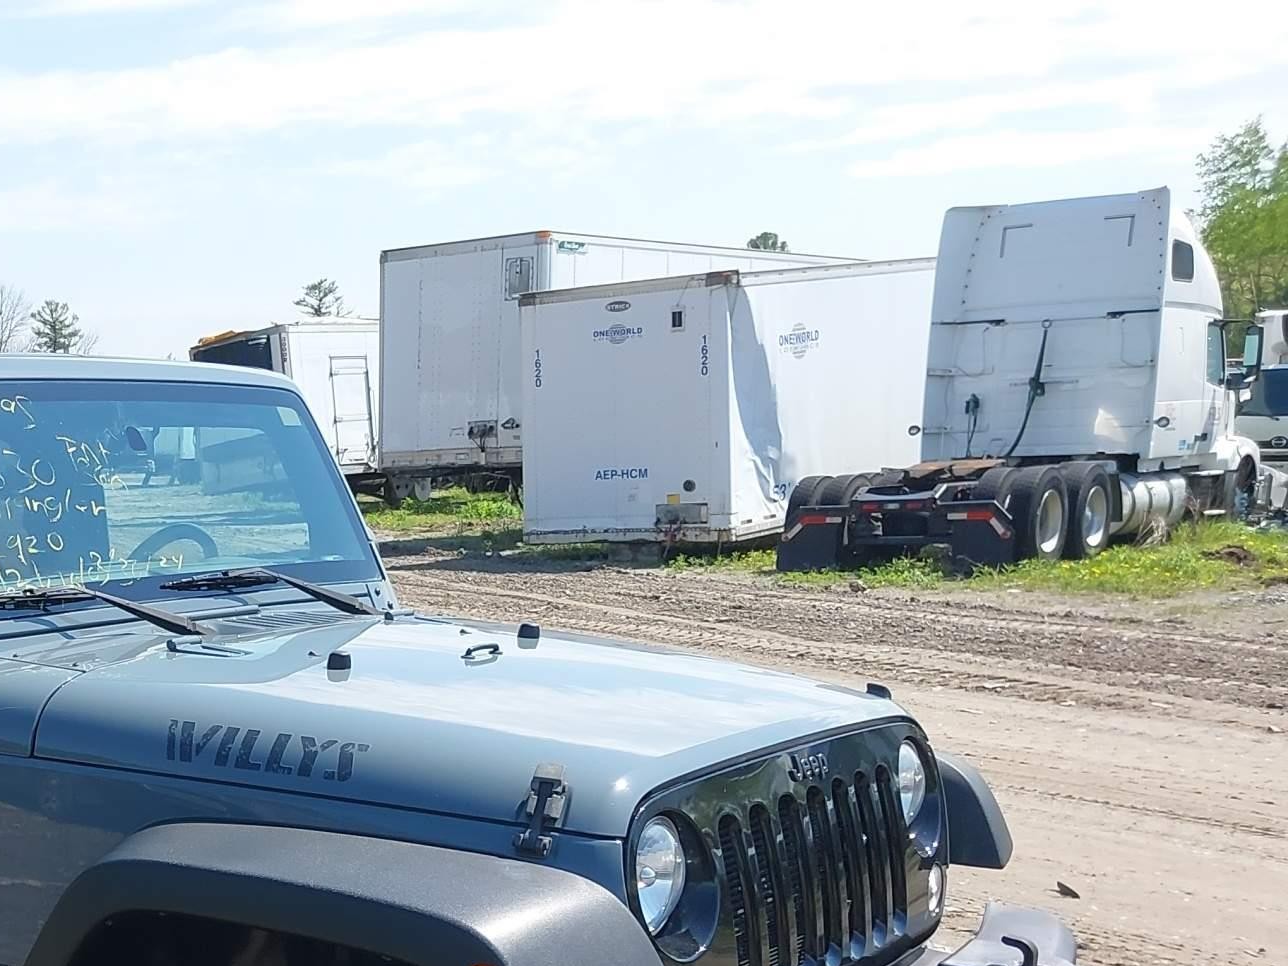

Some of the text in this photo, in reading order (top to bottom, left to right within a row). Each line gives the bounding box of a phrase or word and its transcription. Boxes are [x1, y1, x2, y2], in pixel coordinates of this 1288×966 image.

[534, 349, 542, 388] 1620
[701, 334, 709, 376] 1620
[595, 467, 649, 481] AEP-HCM
[166, 718, 371, 783] WILLYS
[787, 753, 829, 783] Jeep
